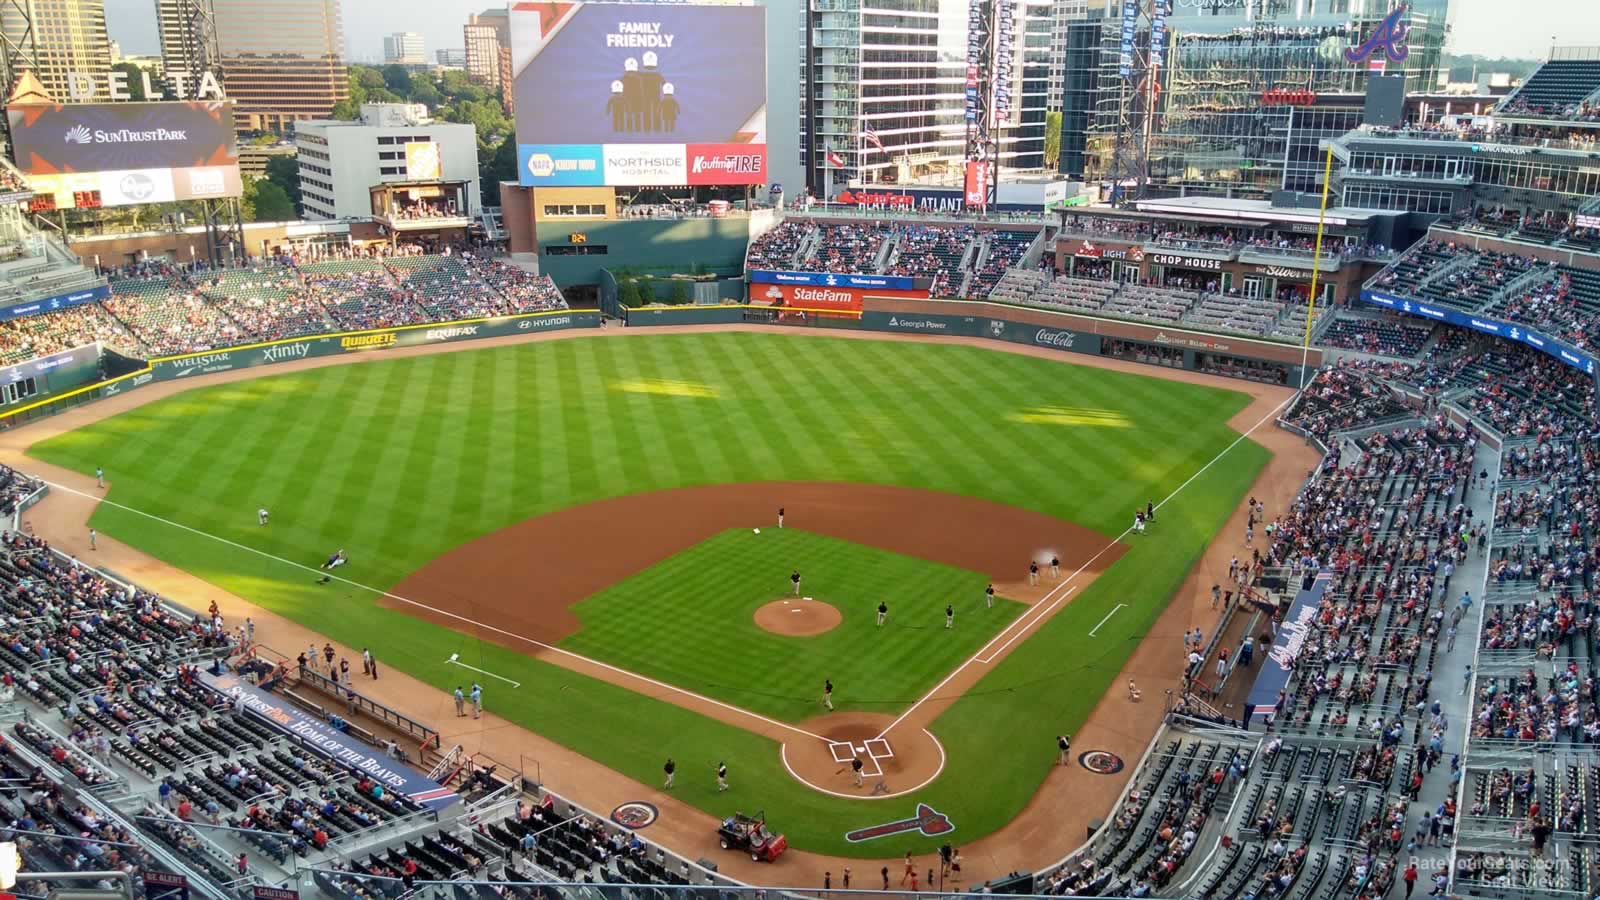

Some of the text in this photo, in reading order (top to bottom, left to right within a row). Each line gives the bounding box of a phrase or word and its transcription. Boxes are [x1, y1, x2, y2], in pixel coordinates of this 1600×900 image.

[618, 22, 661, 34] FAMILY
[606, 33, 674, 48] FRIENDLY
[67, 71, 225, 99] DELTA
[608, 157, 682, 168] NORTHSIDE
[726, 154, 761, 173] TIRE
[622, 168, 670, 176] HOSPITAL
[920, 197, 963, 212] ATLANT
[1102, 249, 1126, 259] LIGHT
[1153, 254, 1221, 270] CHOP HOUSE
[1266, 265, 1300, 278] Silver
[533, 317, 570, 327] HYUNDAI
[899, 319, 947, 329] Georgia Power
[340, 333, 397, 347] QUIKRETE
[425, 326, 480, 340] EQUIFAX
[263, 343, 310, 362] xfinity
[172, 352, 230, 368] WELLSTAR
[290, 720, 408, 786] HOME OF THE BRAVES
[146, 872, 183, 884] BE ALERT
[258, 889, 294, 899] CAUTION
